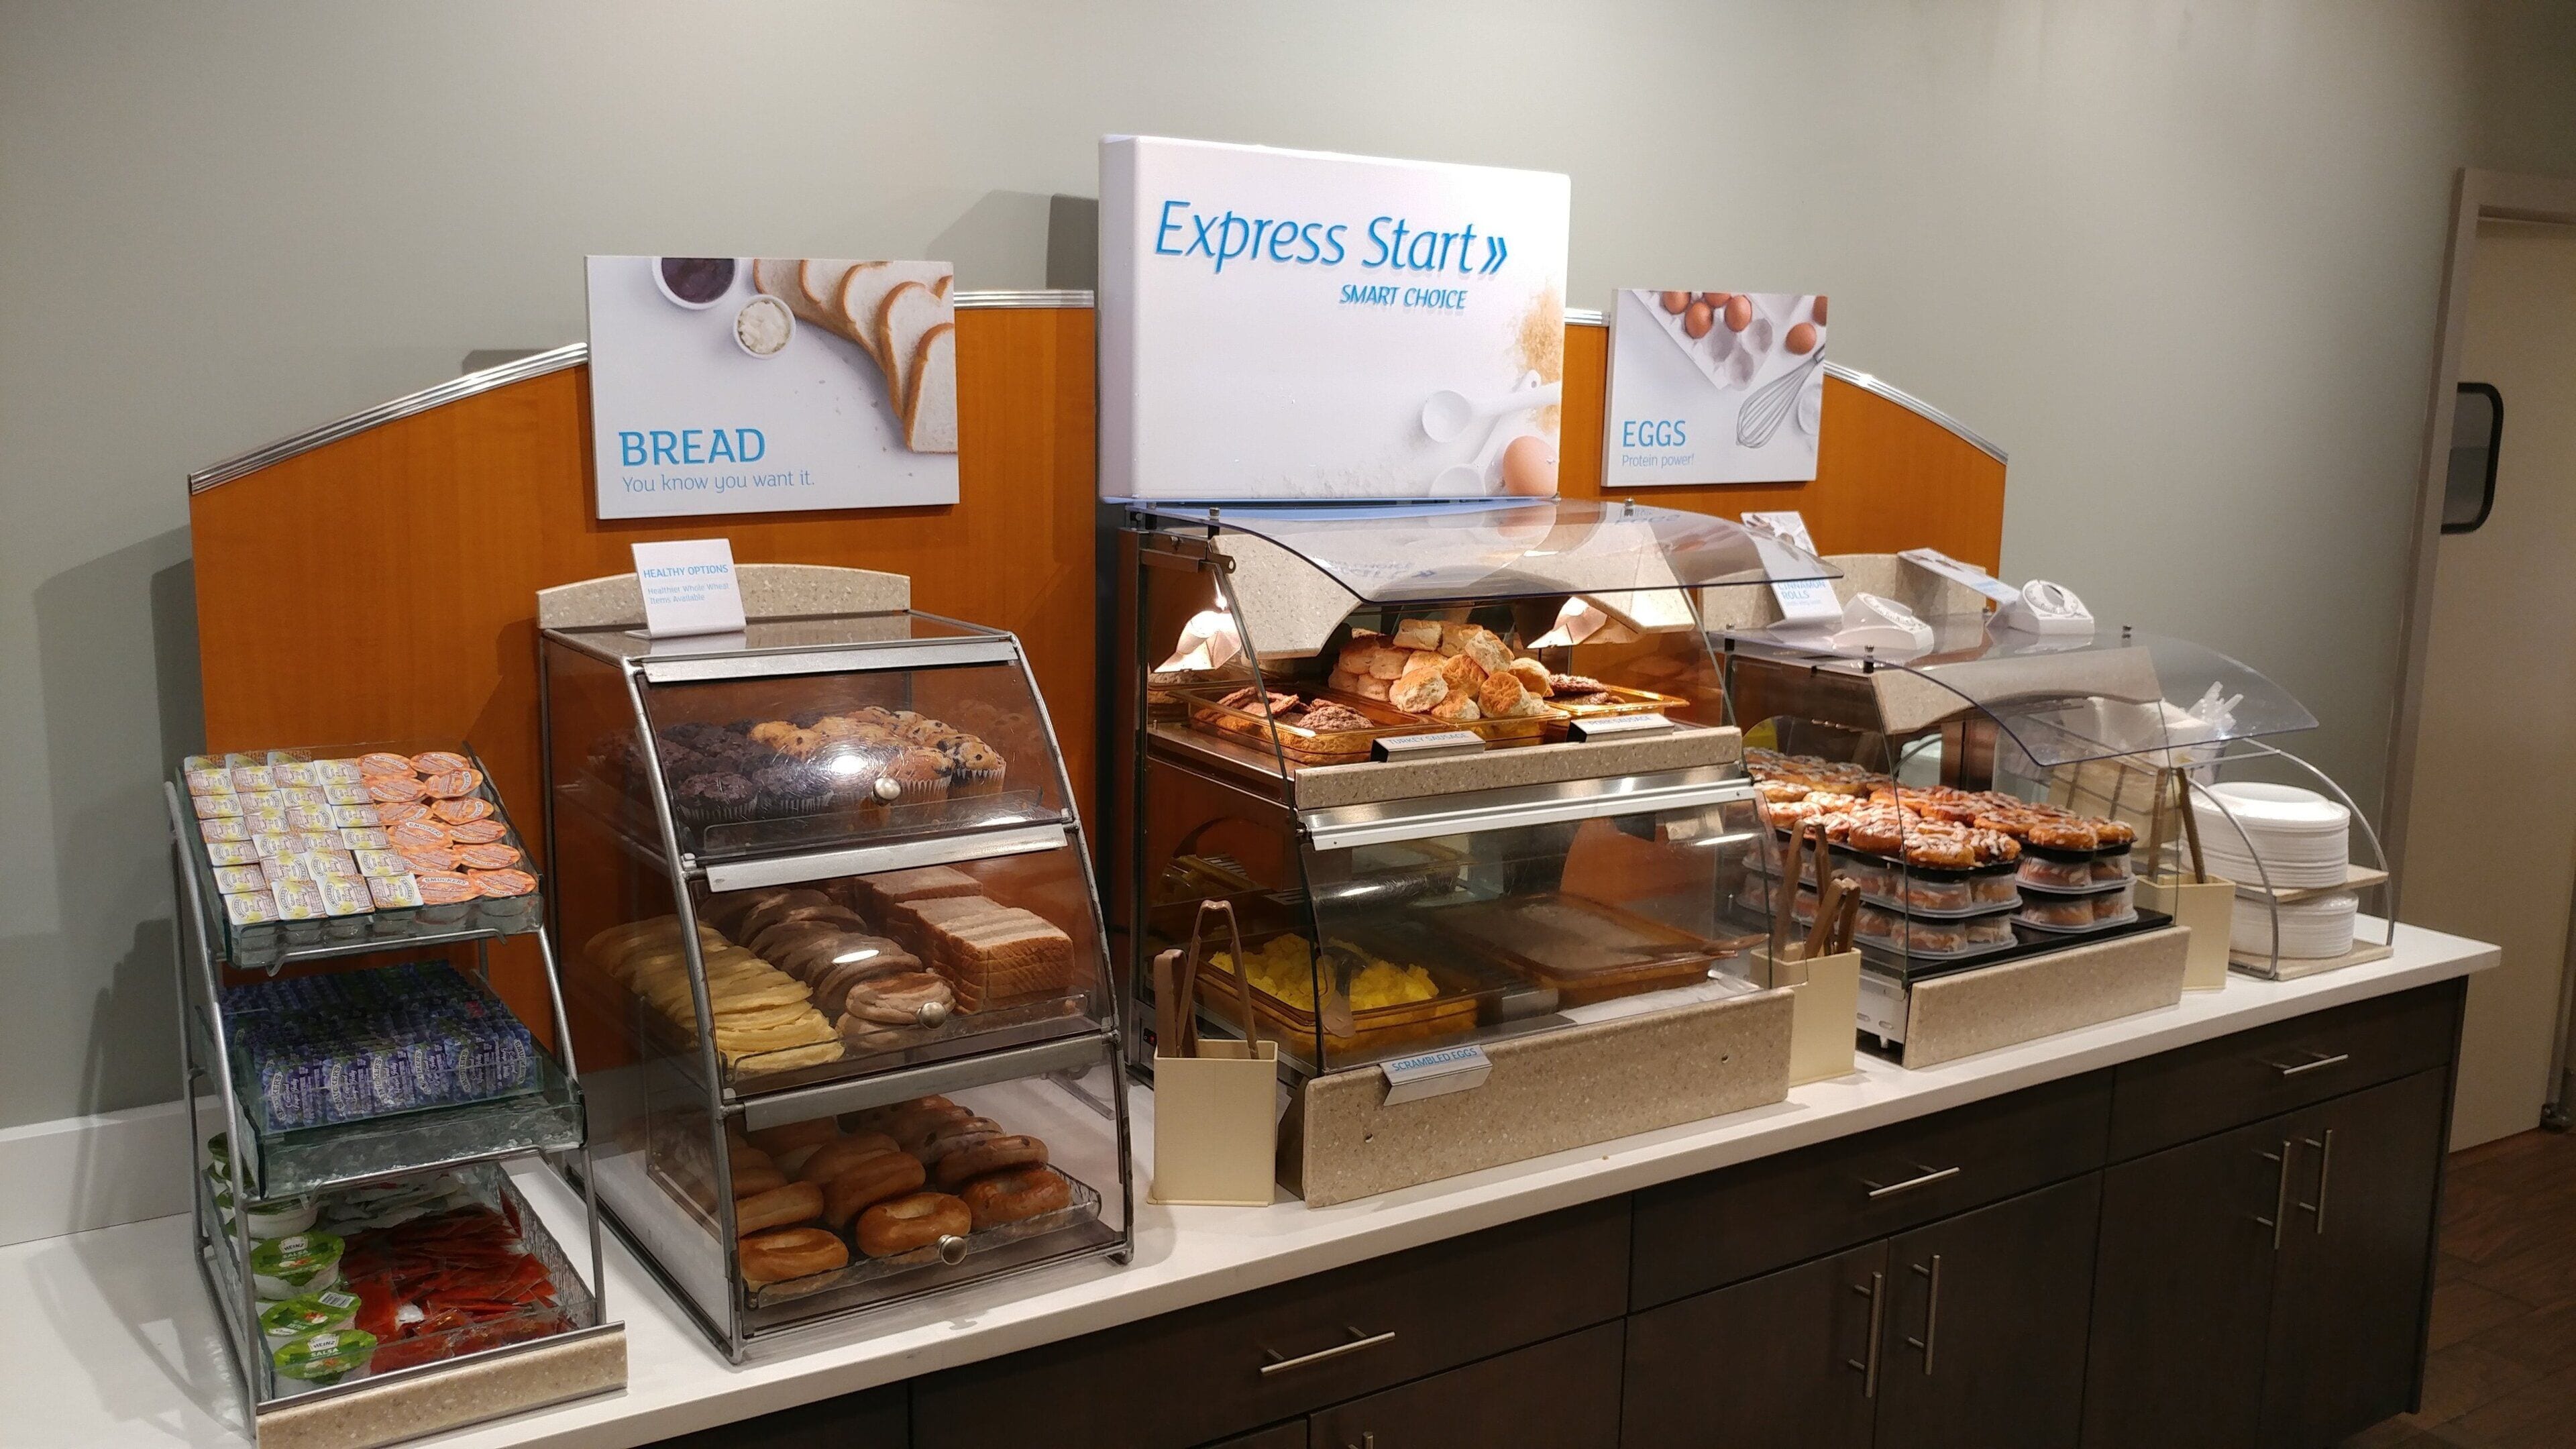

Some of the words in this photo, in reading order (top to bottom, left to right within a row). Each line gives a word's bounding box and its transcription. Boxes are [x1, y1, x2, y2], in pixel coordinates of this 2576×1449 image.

[1155, 201, 1348, 274] Express
[1362, 216, 1477, 274] Start
[1340, 284, 1401, 305] SMART
[1403, 288, 1468, 309] CHOICE
[1622, 420, 1686, 447] EGGS
[619, 428, 765, 467] BREAD
[1622, 454, 1658, 467] Protein
[1661, 453, 1695, 469] power!
[623, 476, 655, 492] You
[661, 474, 708, 492] know
[715, 474, 747, 493] you
[753, 470, 794, 488] want
[800, 470, 815, 486] it.
[643, 567, 685, 578] HEALTHY
[688, 564, 729, 576] OPTIONS
[648, 586, 681, 595] Healthier
[683, 584, 704, 592] Whole
[706, 582, 730, 590] Wheat
[1781, 590, 1810, 600] ROLLS
[650, 596, 671, 604] Items
[673, 594, 705, 602] Available
[1613, 715, 1653, 724] SAUSAGE
[1387, 737, 1423, 745] TURKEY
[1425, 733, 1470, 742] SAUSAGE
[1392, 1053, 1451, 1071] SCRAMBLED
[1453, 1047, 1477, 1059] EGGS
[284, 1242, 305, 1251] HEINZ
[282, 1250, 309, 1259] SALSA
[313, 1340, 335, 1348] HEINZ
[311, 1348, 339, 1358] SALSA
